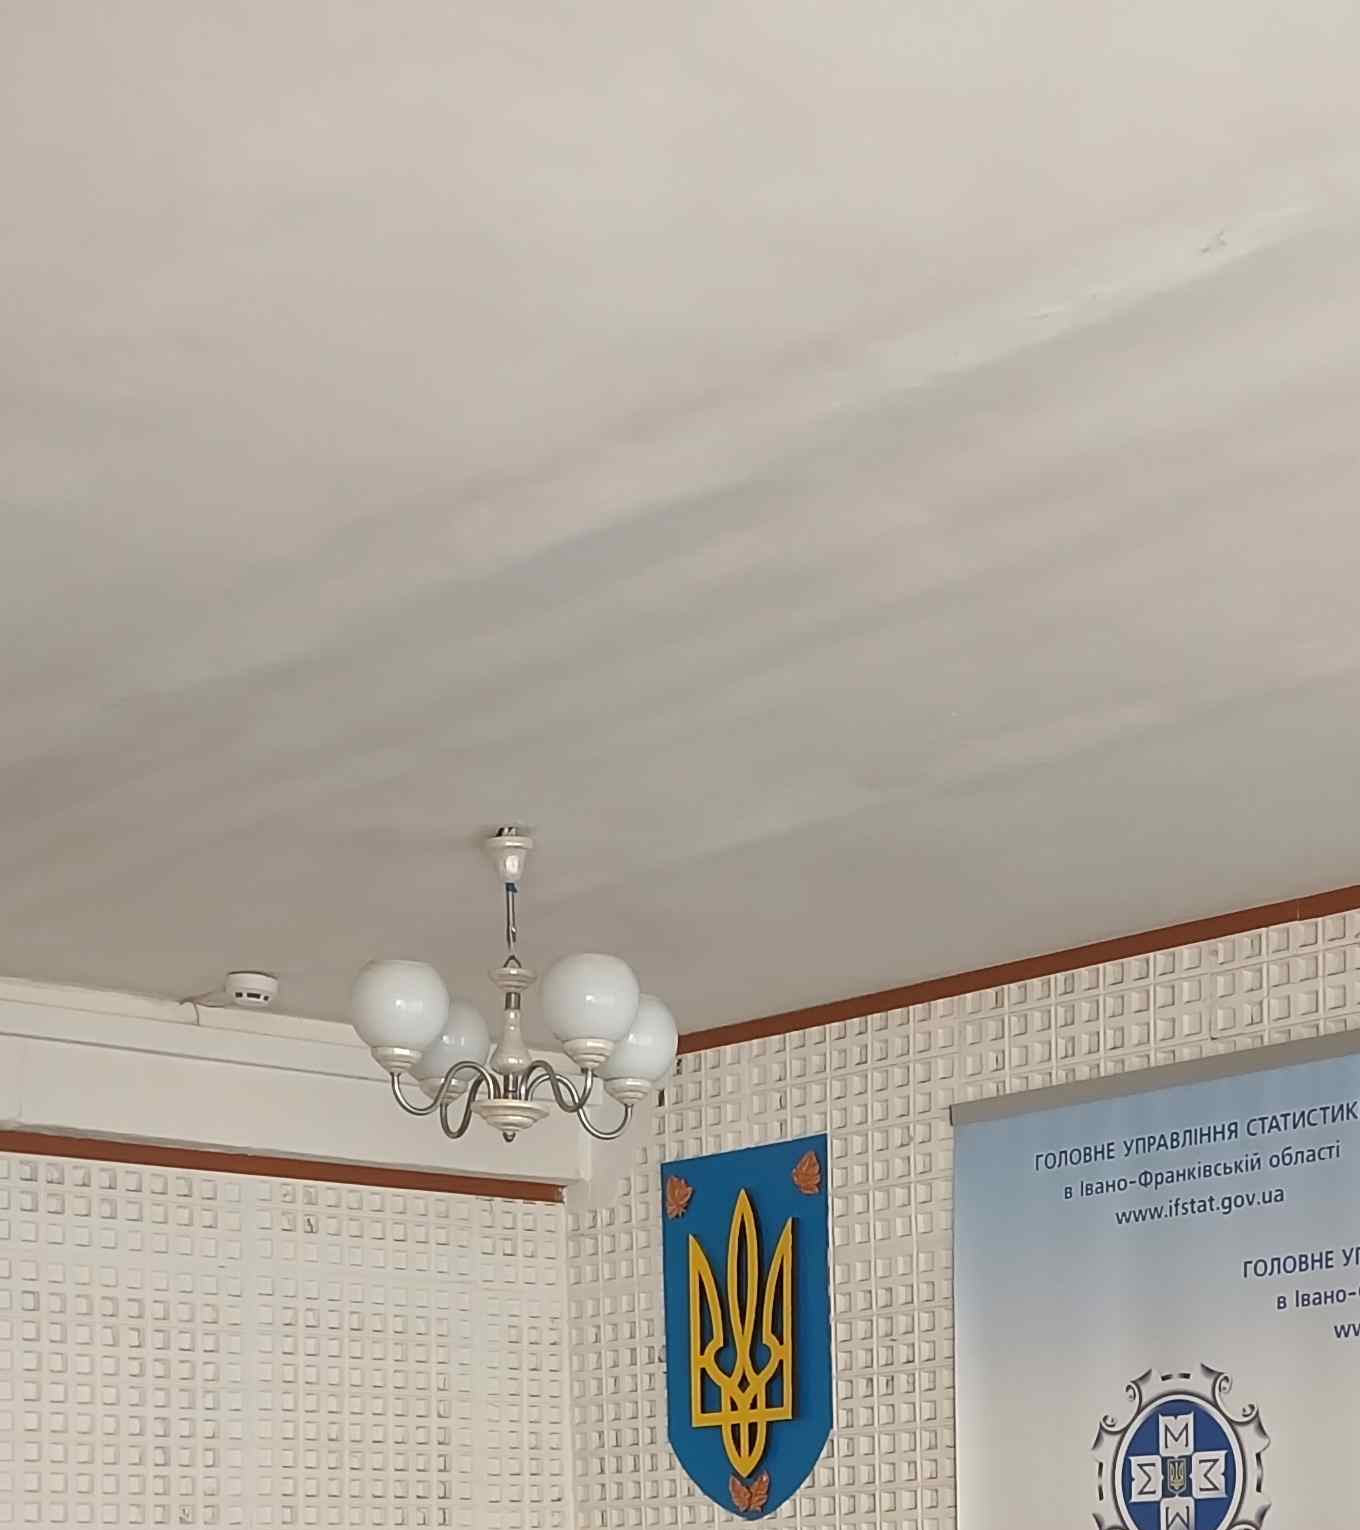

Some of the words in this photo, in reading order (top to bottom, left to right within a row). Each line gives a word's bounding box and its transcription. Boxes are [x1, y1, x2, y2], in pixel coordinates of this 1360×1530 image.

[1036, 1142, 1115, 1171] ГОЛОВНЕ
[1123, 1122, 1238, 1157] УПРАВЛІННЯ
[1065, 1187, 1072, 1199] в
[1081, 1154, 1261, 1198] Івано-Франківській
[1269, 1140, 1340, 1168] області
[1115, 1187, 1284, 1224] www.ifstat.gov.ua
[1244, 1250, 1334, 1278] ГОЛОВНЕ
[1277, 1296, 1287, 1310] в
